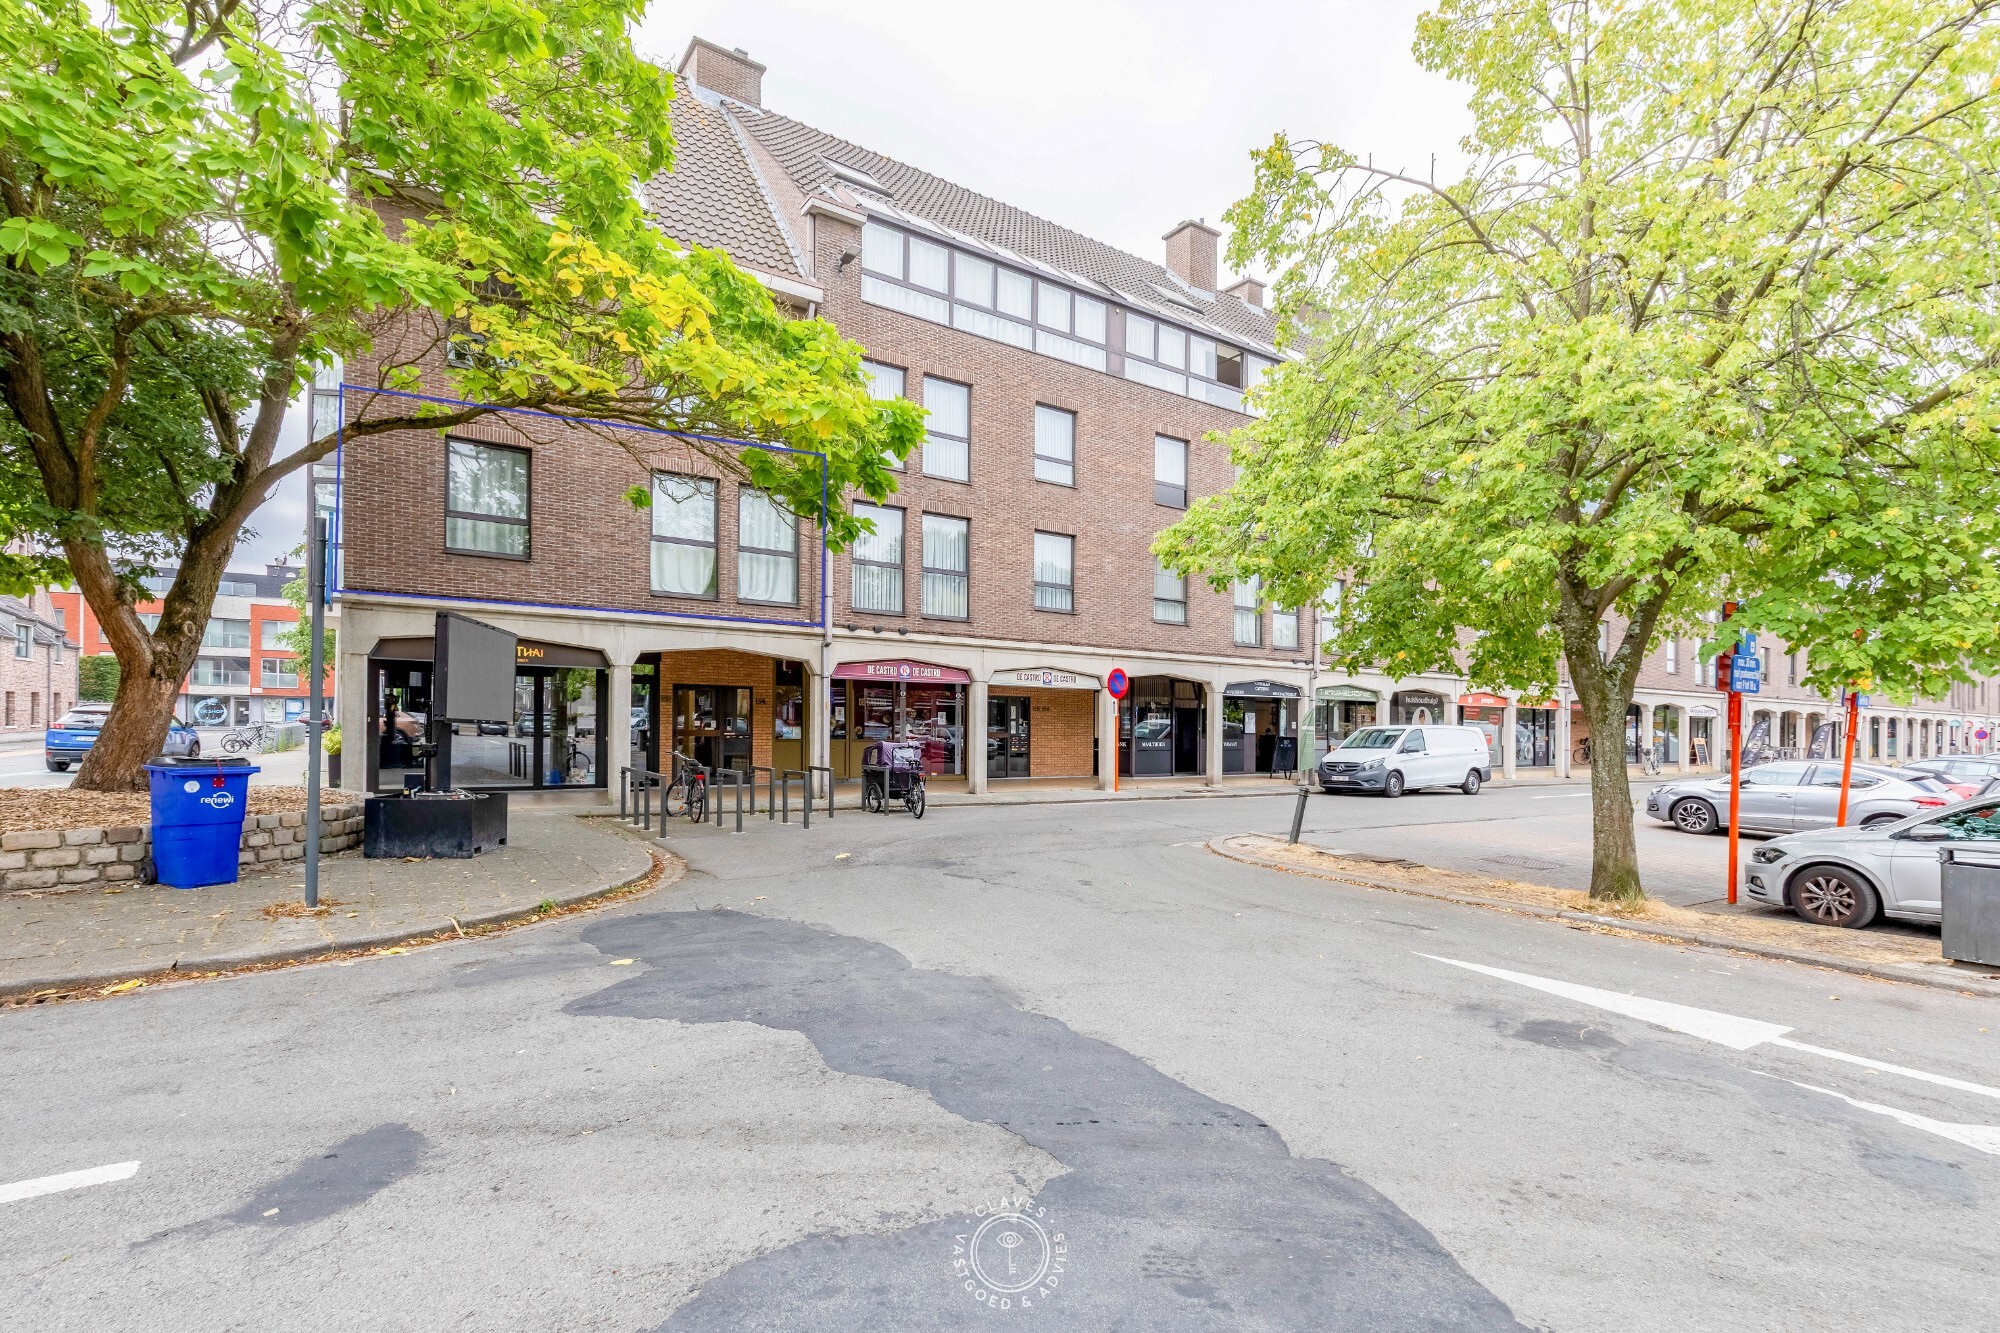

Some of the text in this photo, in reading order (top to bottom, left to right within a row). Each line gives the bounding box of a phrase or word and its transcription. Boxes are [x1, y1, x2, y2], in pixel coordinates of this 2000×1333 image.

[867, 665, 875, 674] DE
[876, 665, 897, 676] CASTRO
[912, 667, 920, 676] DE
[920, 668, 941, 677] CASTRO
[1016, 672, 1023, 680] DE
[1024, 673, 1041, 682] CASTRO
[1053, 674, 1059, 683] DE
[1060, 675, 1077, 684] CASTRO
[200, 794, 234, 804] renewi
